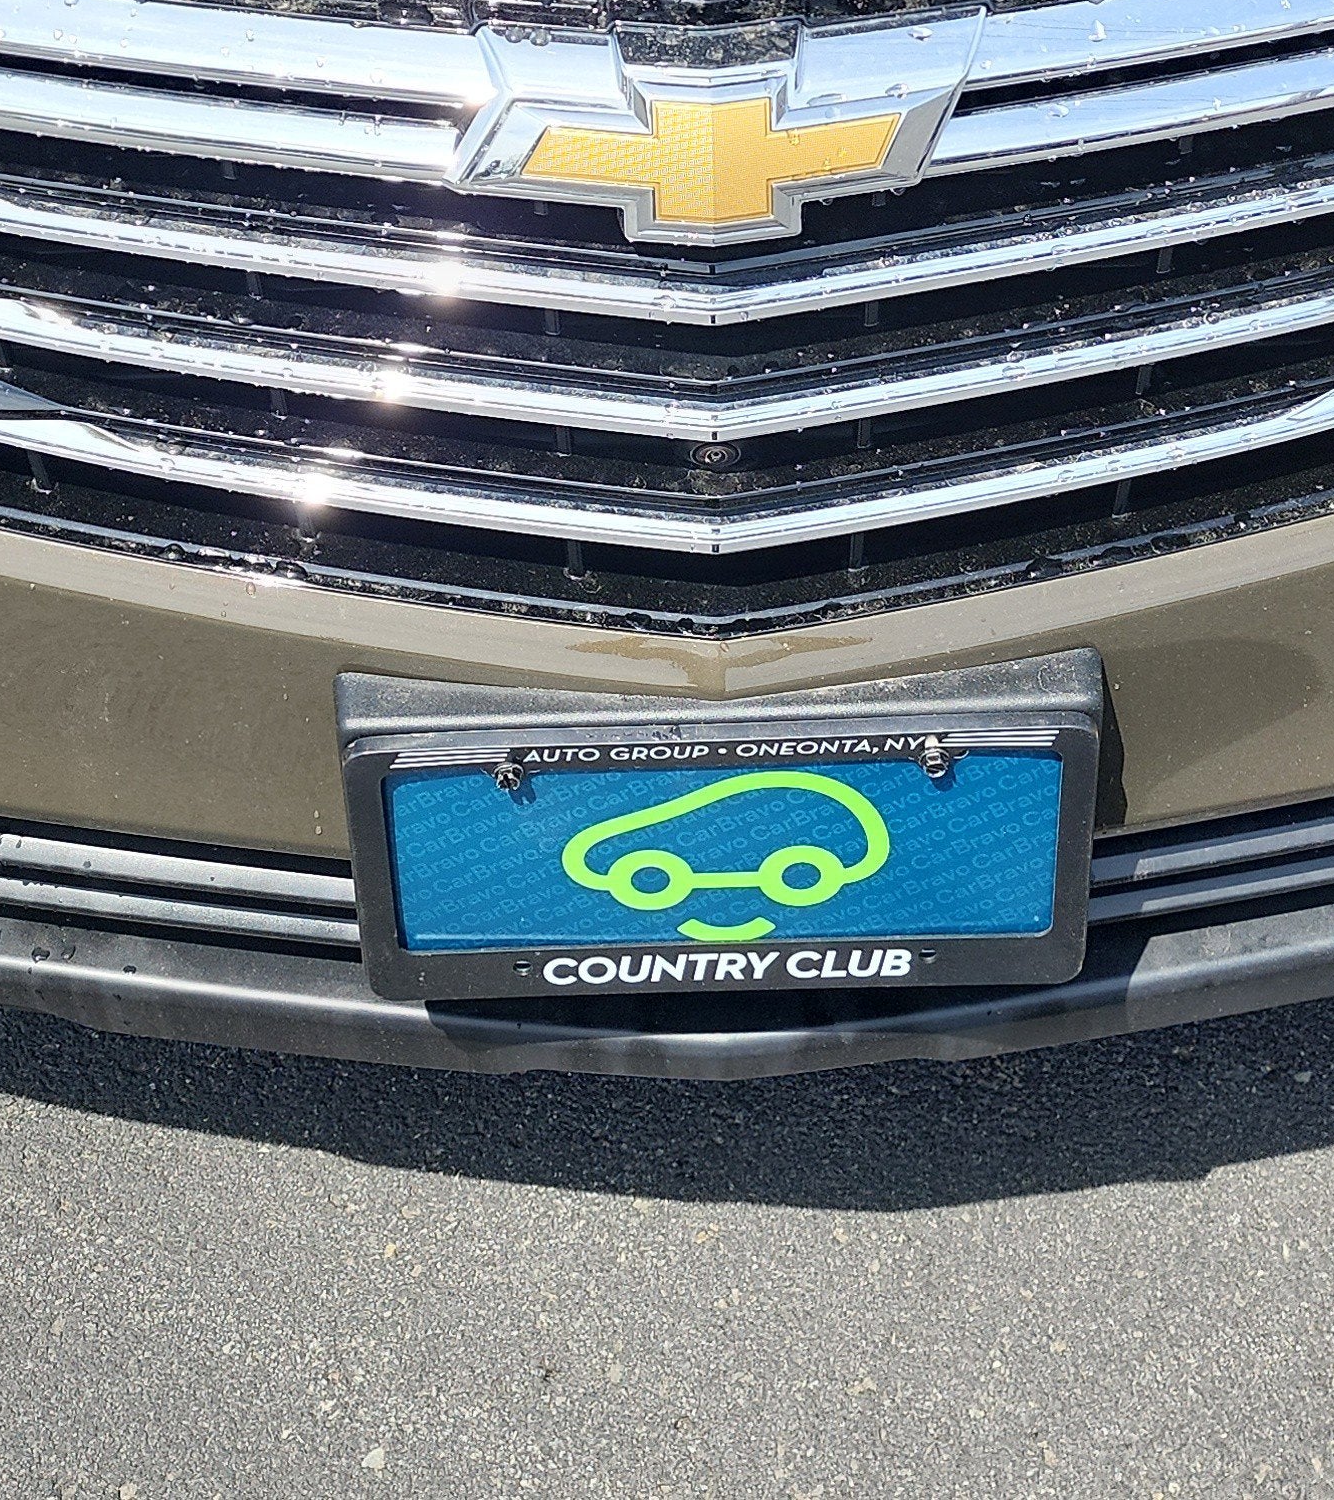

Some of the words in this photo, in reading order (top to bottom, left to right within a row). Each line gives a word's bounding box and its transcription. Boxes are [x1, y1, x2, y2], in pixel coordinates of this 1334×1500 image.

[523, 748, 601, 764] AUTO
[610, 745, 710, 762] GROUP
[542, 951, 780, 986] COUNTRY
[785, 949, 912, 979] CLUB
